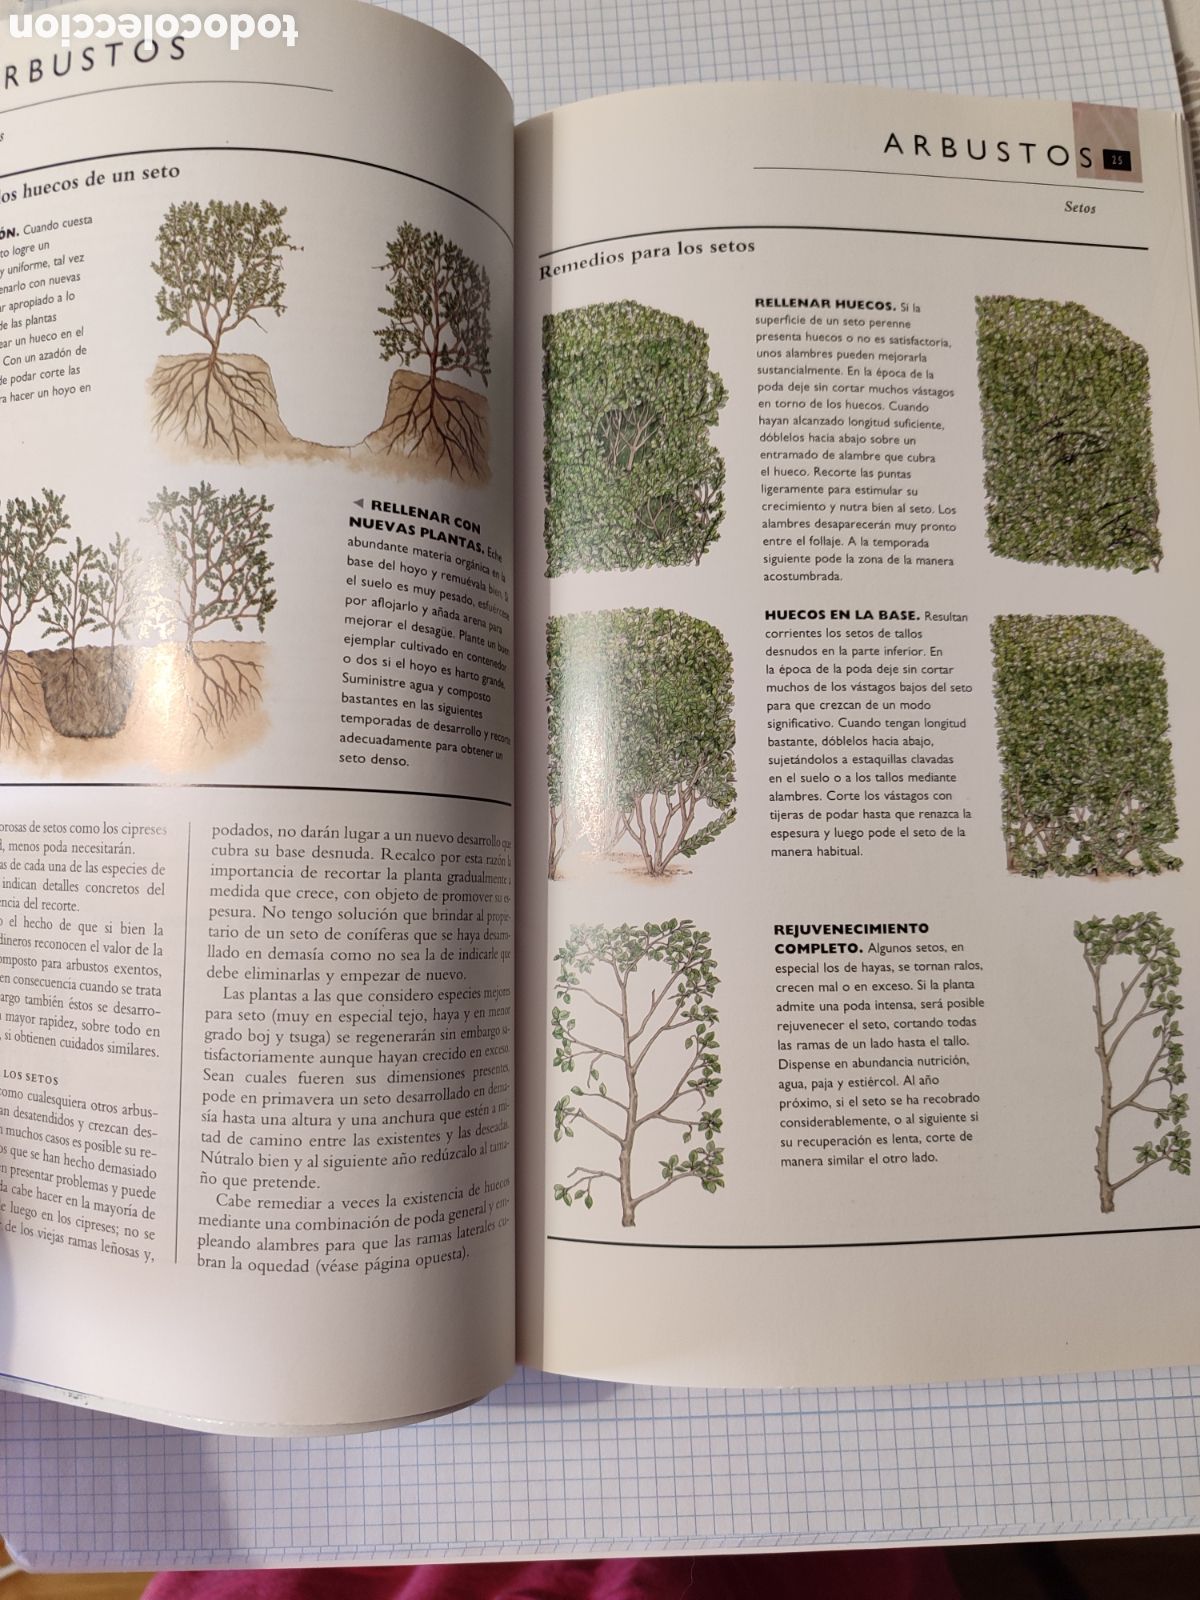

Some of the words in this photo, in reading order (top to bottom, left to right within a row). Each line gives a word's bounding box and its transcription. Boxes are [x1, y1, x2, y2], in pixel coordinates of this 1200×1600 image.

[884, 133, 1092, 168] ARBUSTOS
[1111, 155, 1124, 165] 25
[22, 178, 79, 199] huecos
[84, 170, 106, 187] de
[112, 170, 136, 183] un
[141, 166, 181, 180] seto
[1063, 201, 1097, 214] Setos
[22, 220, 60, 235] Cuando
[61, 217, 94, 228] cuesta
[12, 245, 35, 257] logre
[38, 242, 50, 251] un
[6, 261, 51, 275] uniforme,
[52, 254, 66, 266] tal
[68, 255, 86, 263] vez
[539, 251, 624, 281] Remedios
[631, 247, 671, 265] para
[677, 241, 704, 255] los
[709, 241, 756, 253] setos
[754, 297, 832, 309] RELLENAR
[834, 299, 897, 311] HUECOS.
[912, 303, 922, 313] la
[756, 350, 782, 358] unos
[785, 348, 833, 359] alambres
[836, 349, 875, 361] pueden
[878, 352, 928, 363] mejorarla
[757, 381, 785, 394] poda
[787, 381, 811, 394] deje
[813, 382, 830, 392] sin
[868, 384, 910, 394] muchos
[911, 386, 956, 399] vástagos
[760, 483, 825, 496] ligeramente
[827, 486, 852, 496] para
[854, 485, 904, 495] estimular
[371, 500, 451, 525] RELLENAR
[454, 517, 481, 535] CON
[762, 518, 811, 528] alambres
[814, 518, 891, 531] desaparecerán
[894, 523, 917, 533] muy
[920, 523, 957, 534] pronto
[348, 516, 416, 536] NUEVAS
[420, 527, 485, 553] PLANTAS.
[762, 570, 844, 581] acostumbrada.
[764, 609, 826, 620] HUECOS
[830, 609, 851, 620] EN
[854, 610, 875, 620] LA
[878, 610, 921, 621] BASE.
[924, 611, 968, 622] Resultan
[764, 628, 822, 638] corrientes
[825, 627, 842, 638] los
[845, 630, 874, 638] setos
[877, 628, 891, 638] de
[894, 628, 923, 639] tallos
[342, 672, 406, 688] Suministre
[409, 681, 435, 693] agua
[437, 684, 444, 696] y
[447, 686, 491, 702] composto
[341, 692, 399, 707] bastantes
[402, 700, 417, 709] en
[420, 699, 435, 712] las
[437, 702, 483, 719] siguientes
[766, 718, 835, 731] significativo.
[837, 717, 882, 728] Cuando
[884, 720, 921, 731] tengan
[923, 717, 967, 731] longitud
[339, 732, 432, 749] adecuadamente
[435, 738, 458, 753] para
[460, 743, 494, 759] obtener
[767, 737, 818, 747] bastante,
[821, 736, 868, 746] dóblelos
[872, 736, 900, 746] hacia
[902, 736, 934, 749] abajo,
[338, 754, 367, 763] seto
[370, 753, 410, 766] denso.
[768, 754, 839, 767] sujetándolos
[851, 753, 908, 767] estaquillas
[910, 754, 954, 764] clavadas
[8, 843, 40, 852] menos
[42, 840, 68, 856] poda
[71, 842, 136, 854] necesitarán.
[770, 849, 814, 857] manera
[816, 845, 863, 856] habitual.
[2, 877, 37, 890] indican
[42, 878, 80, 892] detalles
[84, 885, 140, 894] concretos
[146, 882, 165, 895] del
[774, 923, 929, 938] REJUVENECIMIENTO
[774, 943, 864, 954] COMPLETO.
[867, 942, 913, 956] Algunos
[915, 944, 948, 953] setos,
[950, 944, 965, 952] en
[40, 960, 63, 971] para
[65, 958, 109, 973] arbustos
[113, 965, 162, 978] exentos,
[206, 965, 239, 979] debe
[244, 966, 321, 981] eliminarlas
[325, 973, 335, 985] y
[340, 972, 401, 986] empezar
[404, 968, 422, 981] de
[425, 968, 467, 984] nuevo.
[774, 962, 820, 976] especial
[823, 962, 840, 973] los
[843, 962, 858, 973] de
[861, 961, 895, 975] hayas,
[897, 964, 911, 972] se
[913, 963, 951, 971] tornan
[953, 960, 984, 971] ralos,
[776, 1001, 815, 1012] admite
[819, 1003, 840, 1011] una
[843, 1000, 871, 1014] poda
[874, 1000, 917, 1010] intensa,
[920, 998, 944, 1009] será
[946, 997, 985, 1012] posible
[776, 1021, 846, 1034] rejuvenecer
[848, 1018, 859, 1030] el
[861, 1021, 890, 1030] seto,
[892, 1017, 944, 1029] cortando
[946, 1016, 977, 1027] todas
[778, 1059, 831, 1072] Dispense
[834, 1061, 848, 1069] en
[852, 1056, 914, 1068] abundancia
[917, 1054, 970, 1066] nutrición,
[2, 1069, 23, 1080] LOS
[24, 1073, 60, 1085] SETOS
[27, 1090, 87, 1110] cualesquiera
[90, 1102, 118, 1114] otros
[121, 1103, 158, 1118] arbus-
[200, 1150, 254, 1166] Nútralo
[258, 1153, 289, 1167] bien
[293, 1159, 303, 1172] y
[306, 1154, 319, 1168] al
[322, 1154, 388, 1171] siguiente
[391, 1152, 417, 1165] año
[421, 1147, 477, 1163] redúzcalo
[9, 1166, 54, 1182] presentar
[56, 1174, 109, 1192] problemas
[111, 1185, 119, 1197] y
[121, 1186, 157, 1199] puede
[197, 1253, 226, 1268] bran
[230, 1256, 243, 1270] la
[247, 1259, 310, 1276] oquedad
[315, 1258, 359, 1276] (véase
[364, 1256, 410, 1275] página
[415, 1245, 470, 1269] opuesta).
